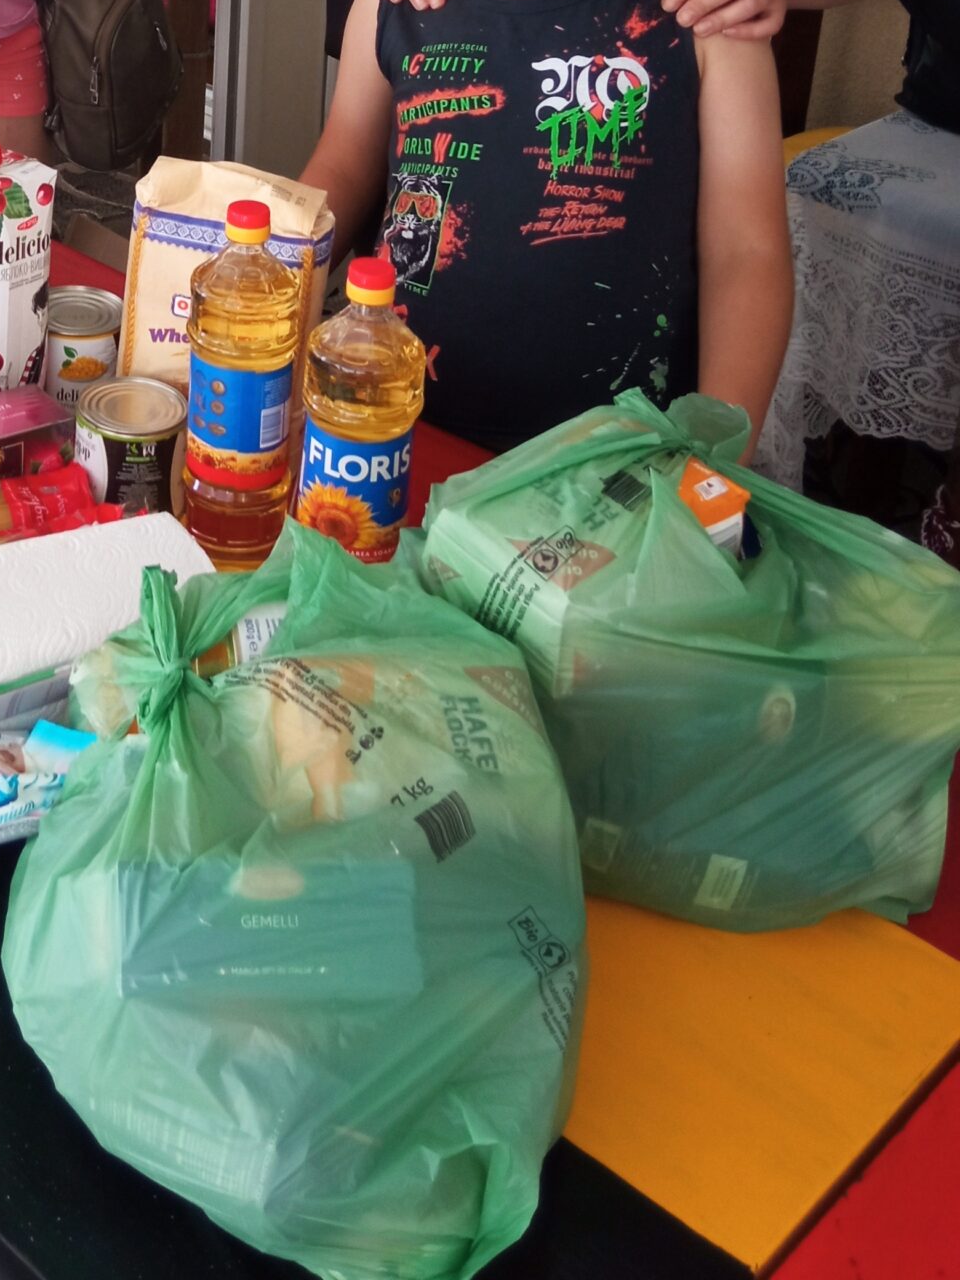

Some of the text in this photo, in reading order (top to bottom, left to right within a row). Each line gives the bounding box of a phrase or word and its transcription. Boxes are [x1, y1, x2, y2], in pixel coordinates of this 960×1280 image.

[402, 54, 485, 75] ACTIVITY
[149, 328, 191, 344] Whe
[56, 387, 80, 402] deli
[309, 434, 411, 483] FLORIS
[440, 695, 473, 762] FLOCK
[456, 696, 499, 770] HAFE
[391, 777, 434, 808] 7 kg
[241, 914, 299, 928] GEMELLI
[517, 916, 539, 943] Bio
